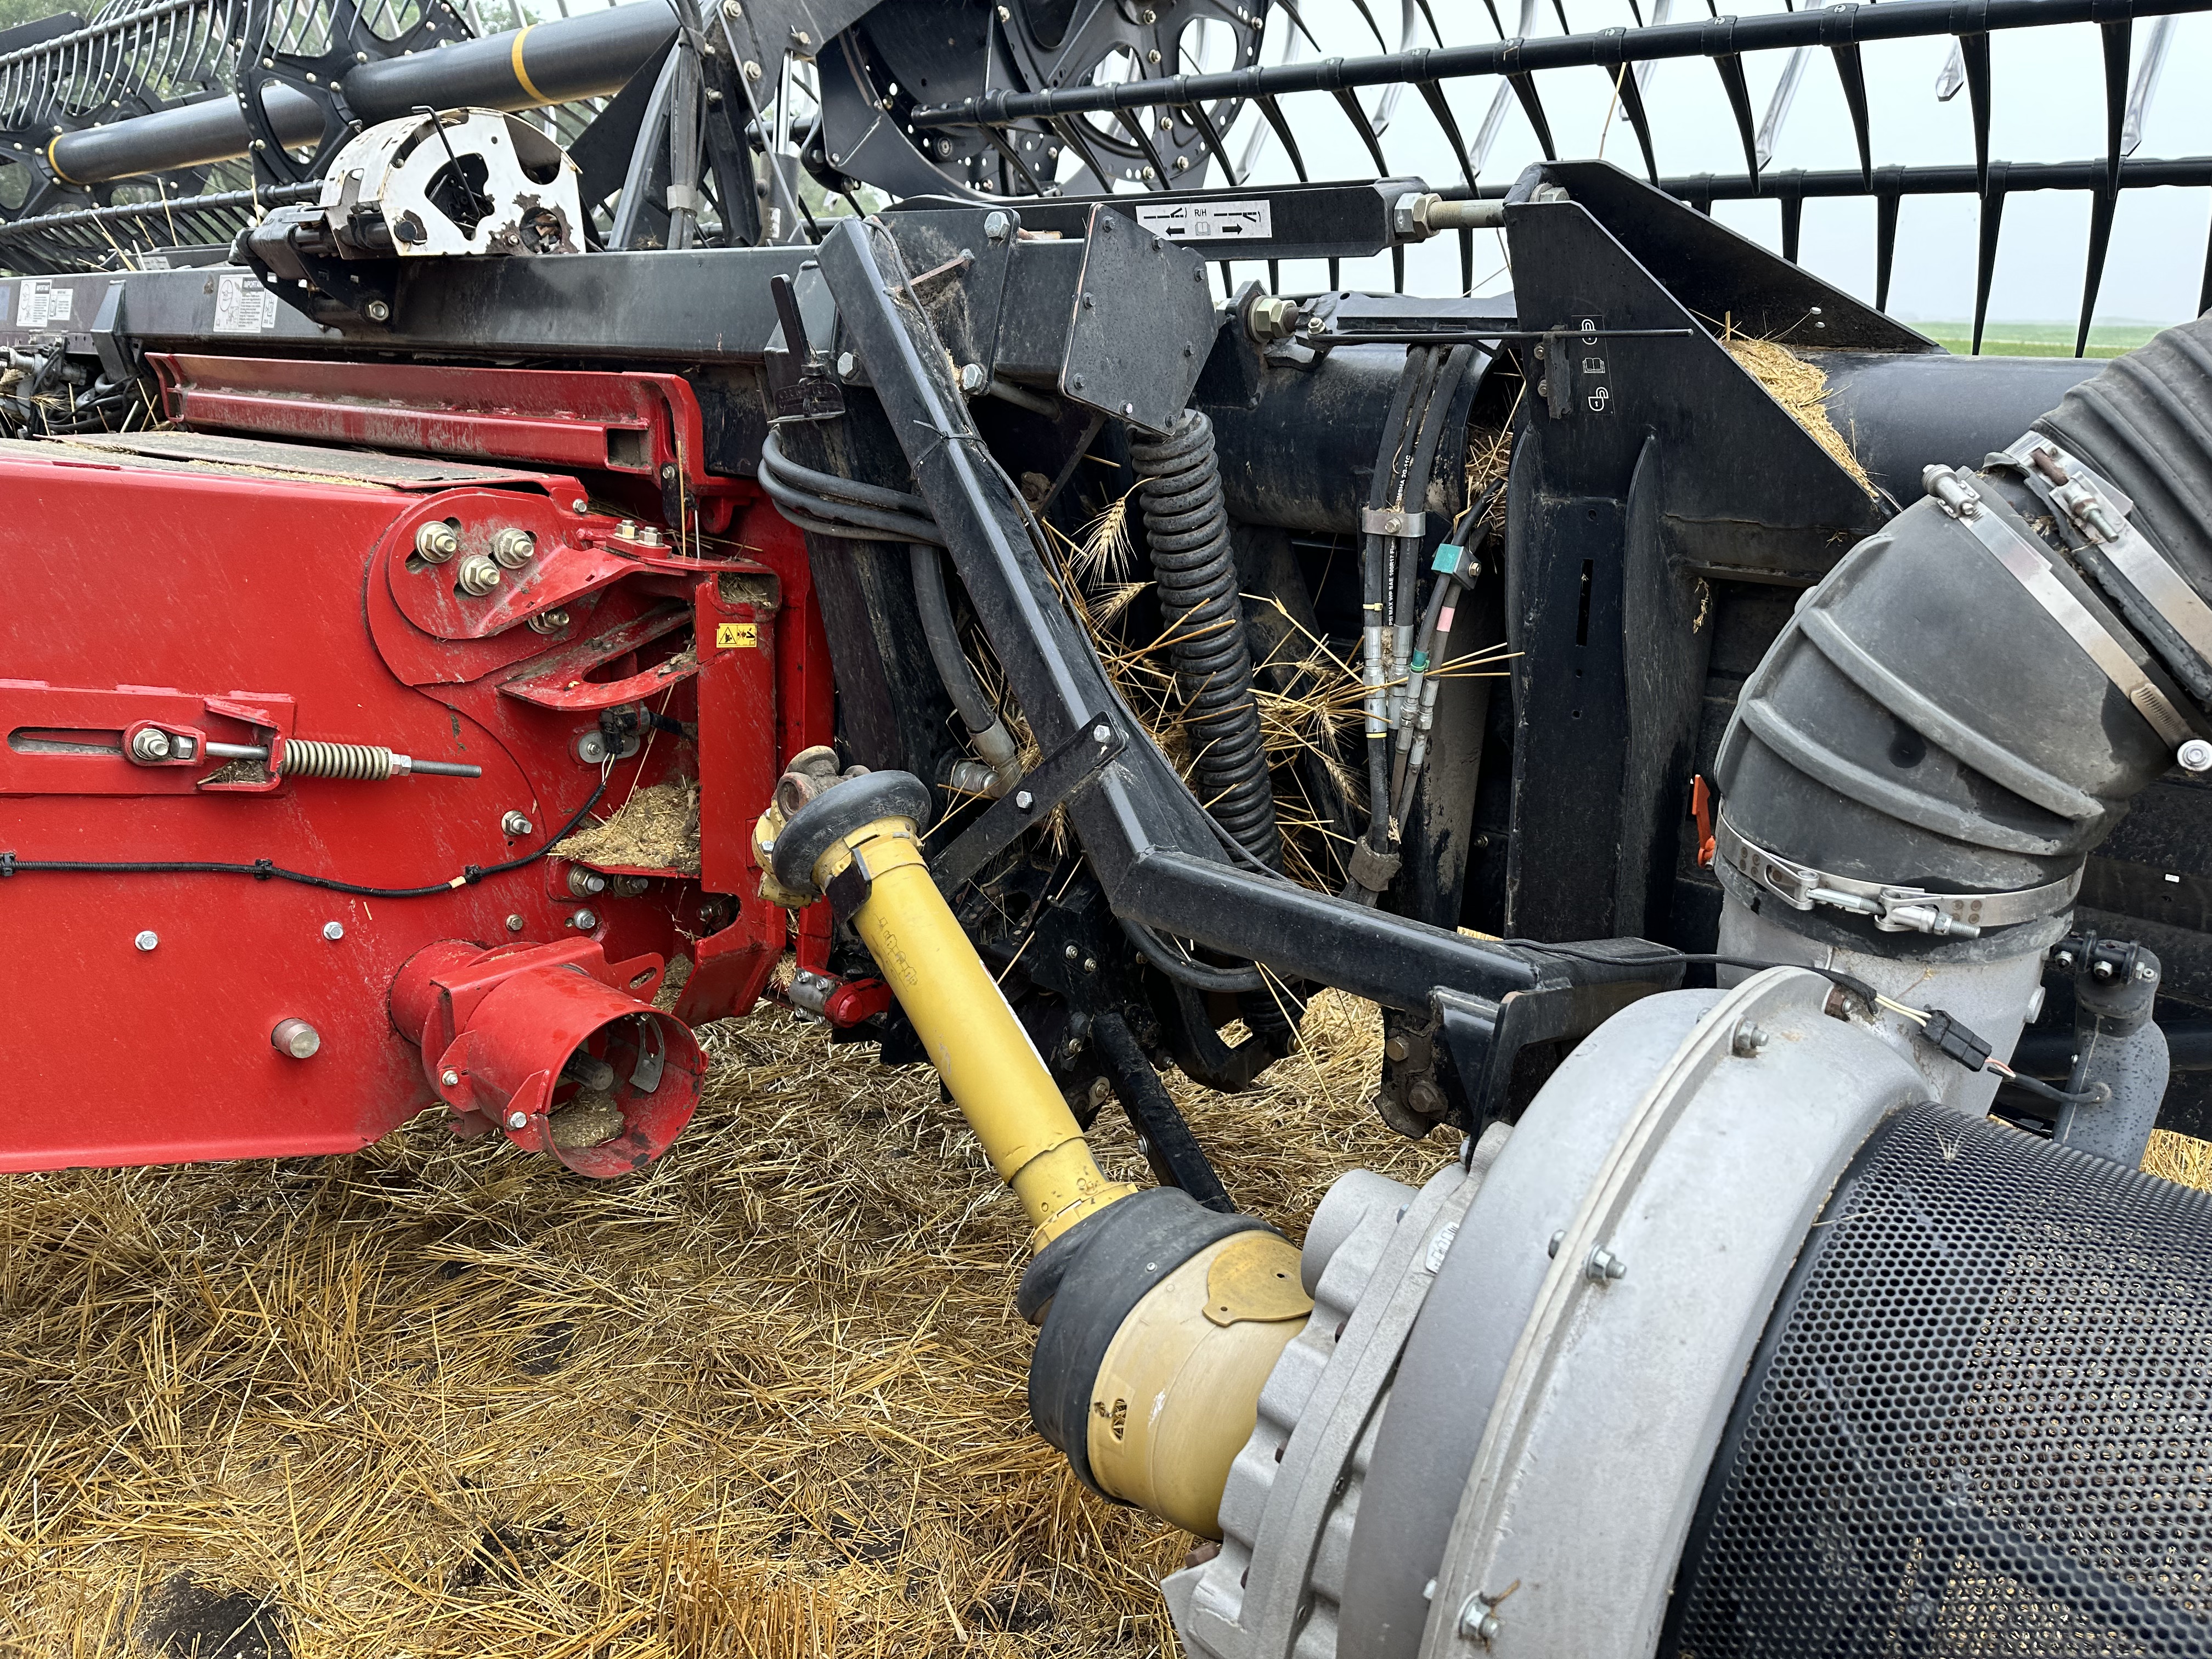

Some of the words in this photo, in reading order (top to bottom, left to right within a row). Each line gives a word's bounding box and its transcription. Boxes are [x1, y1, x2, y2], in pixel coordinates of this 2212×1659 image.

[1194, 208, 1207, 217] R/H
[1402, 455, 1410, 478] 2G-11C
[1389, 591, 1393, 601] WP
